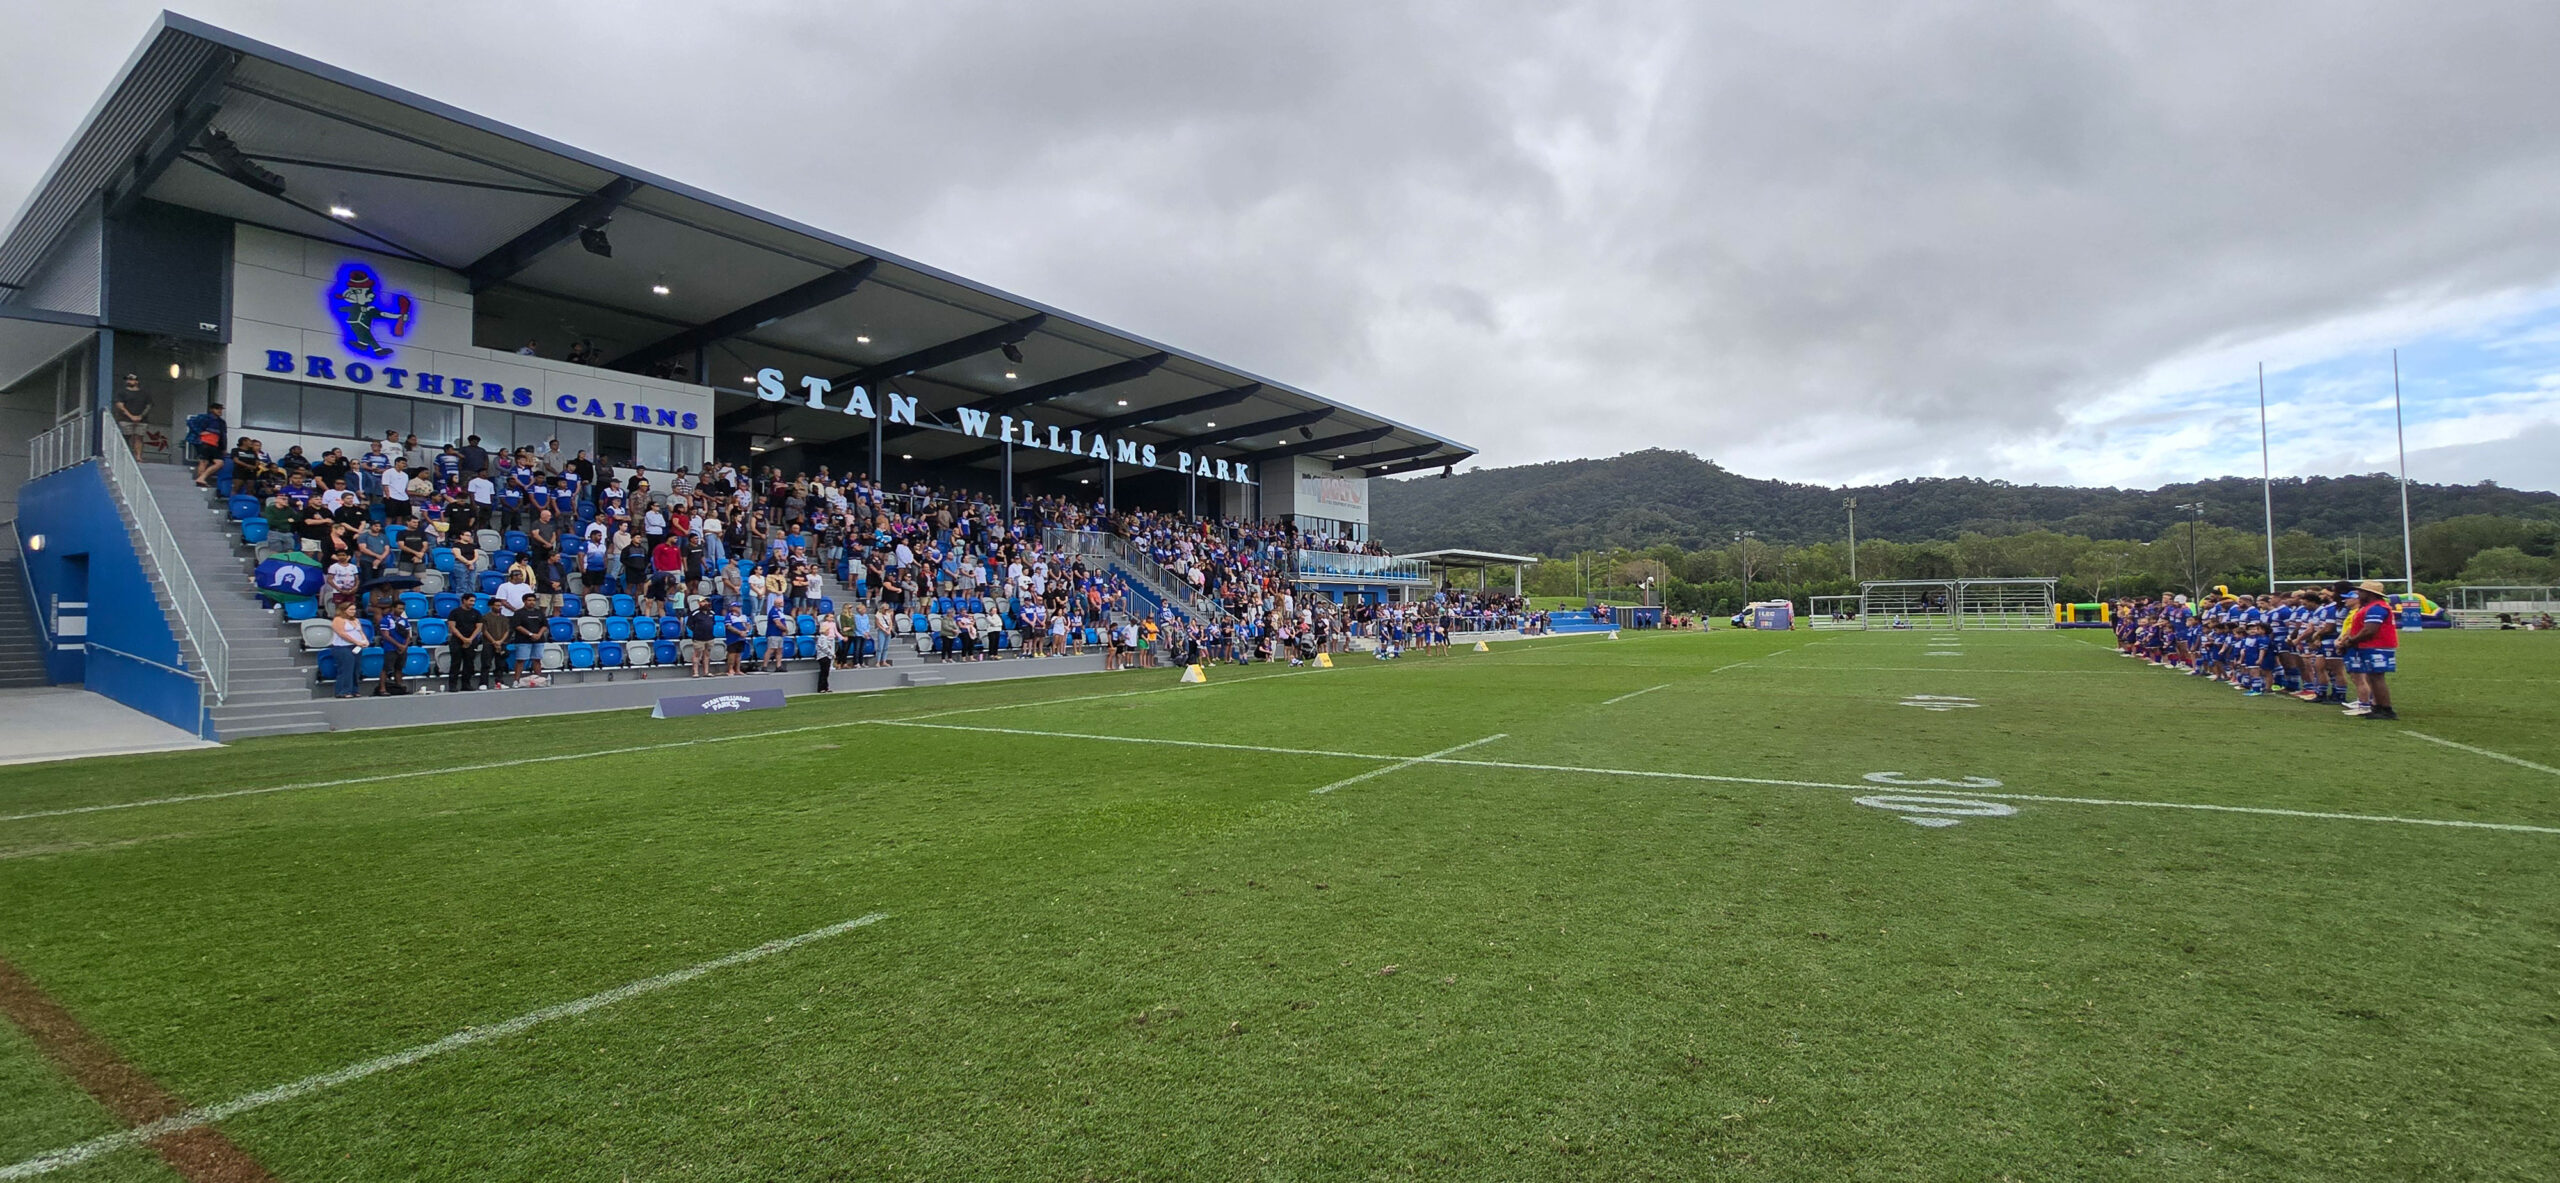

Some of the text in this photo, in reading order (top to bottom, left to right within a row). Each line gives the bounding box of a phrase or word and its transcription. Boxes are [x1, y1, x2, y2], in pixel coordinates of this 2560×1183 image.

[265, 348, 699, 430] BROTHERS CAIRNS
[756, 367, 1254, 484] STAN WILLIAMS PARK
[1851, 771, 2018, 817] 30
